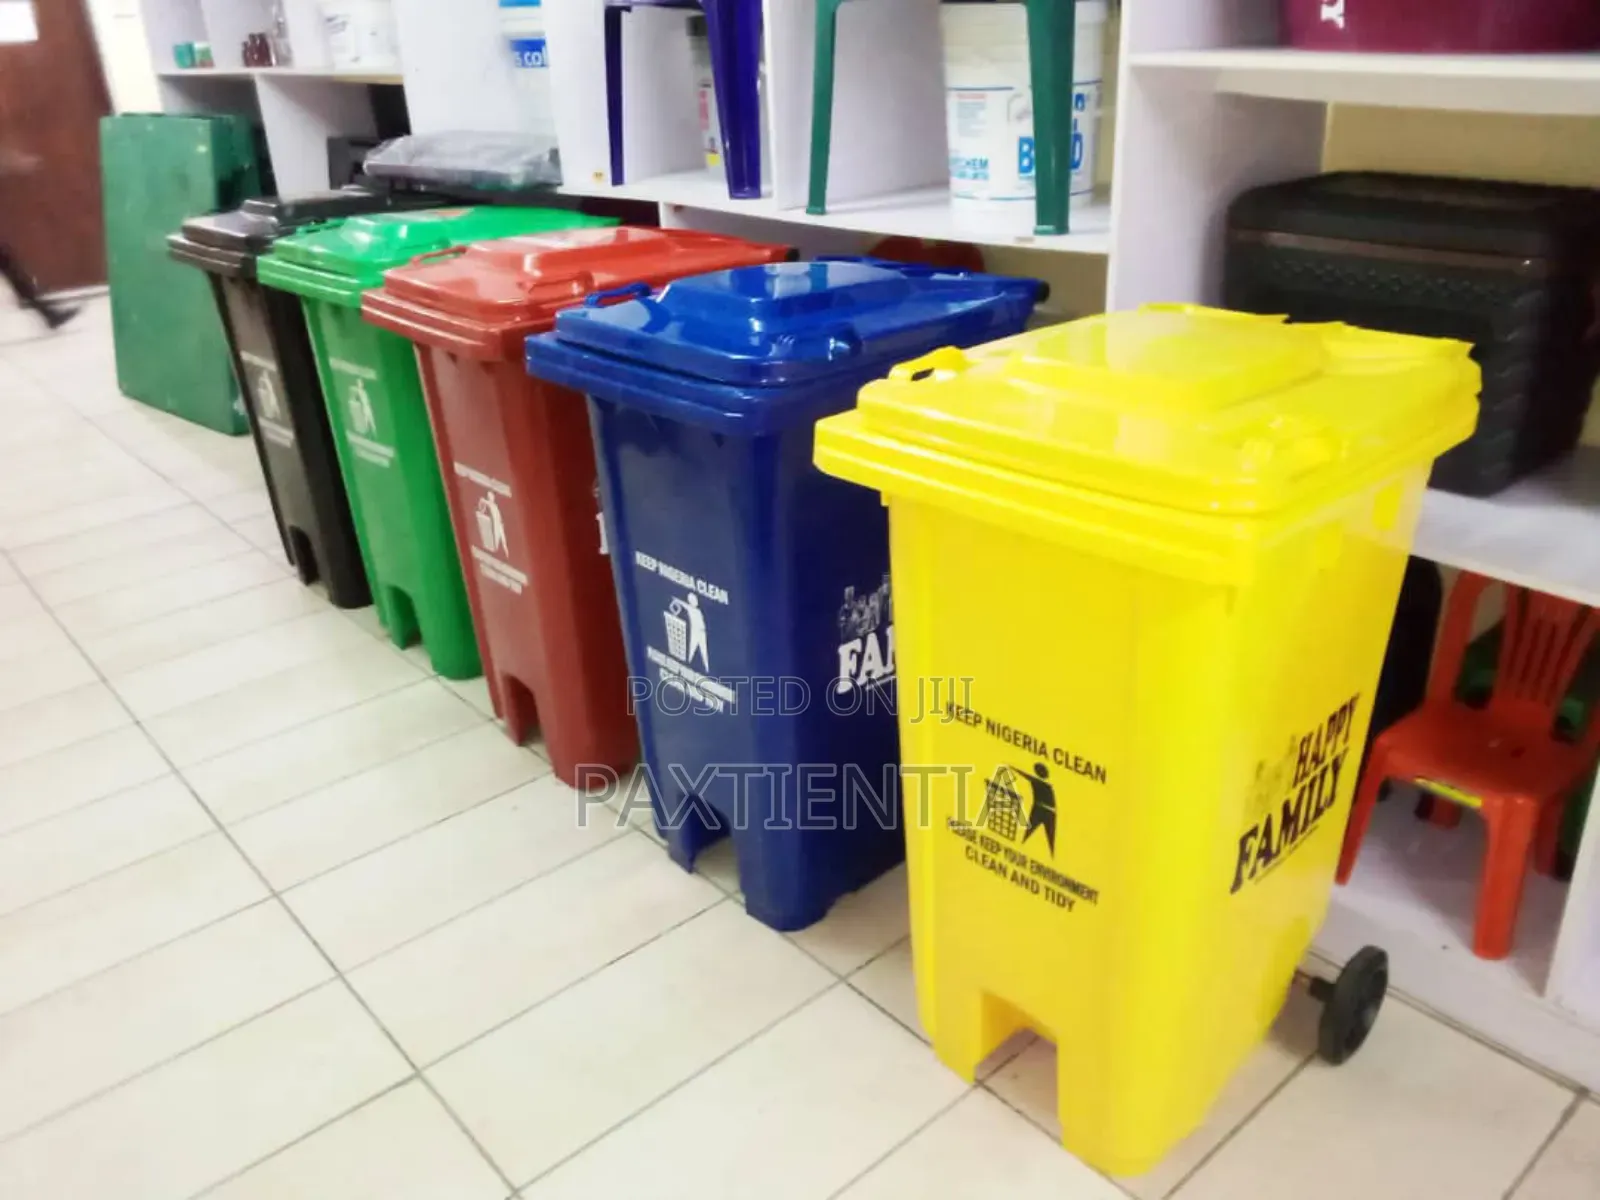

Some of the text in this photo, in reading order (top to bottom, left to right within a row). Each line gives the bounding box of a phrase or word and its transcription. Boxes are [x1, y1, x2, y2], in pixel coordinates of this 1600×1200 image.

[696, 577, 730, 606] CLEAN
[945, 701, 1107, 785] KEEP NIGERIA CLEAN
[1292, 691, 1361, 790] HAPPY
[1230, 745, 1349, 895] FAMILY
[964, 844, 1077, 913] CLEAN AND TIDY
[979, 834, 1002, 856] KEEP
[1002, 846, 1029, 868] YOUR
[1029, 858, 1100, 907] ENVIRONMENT
